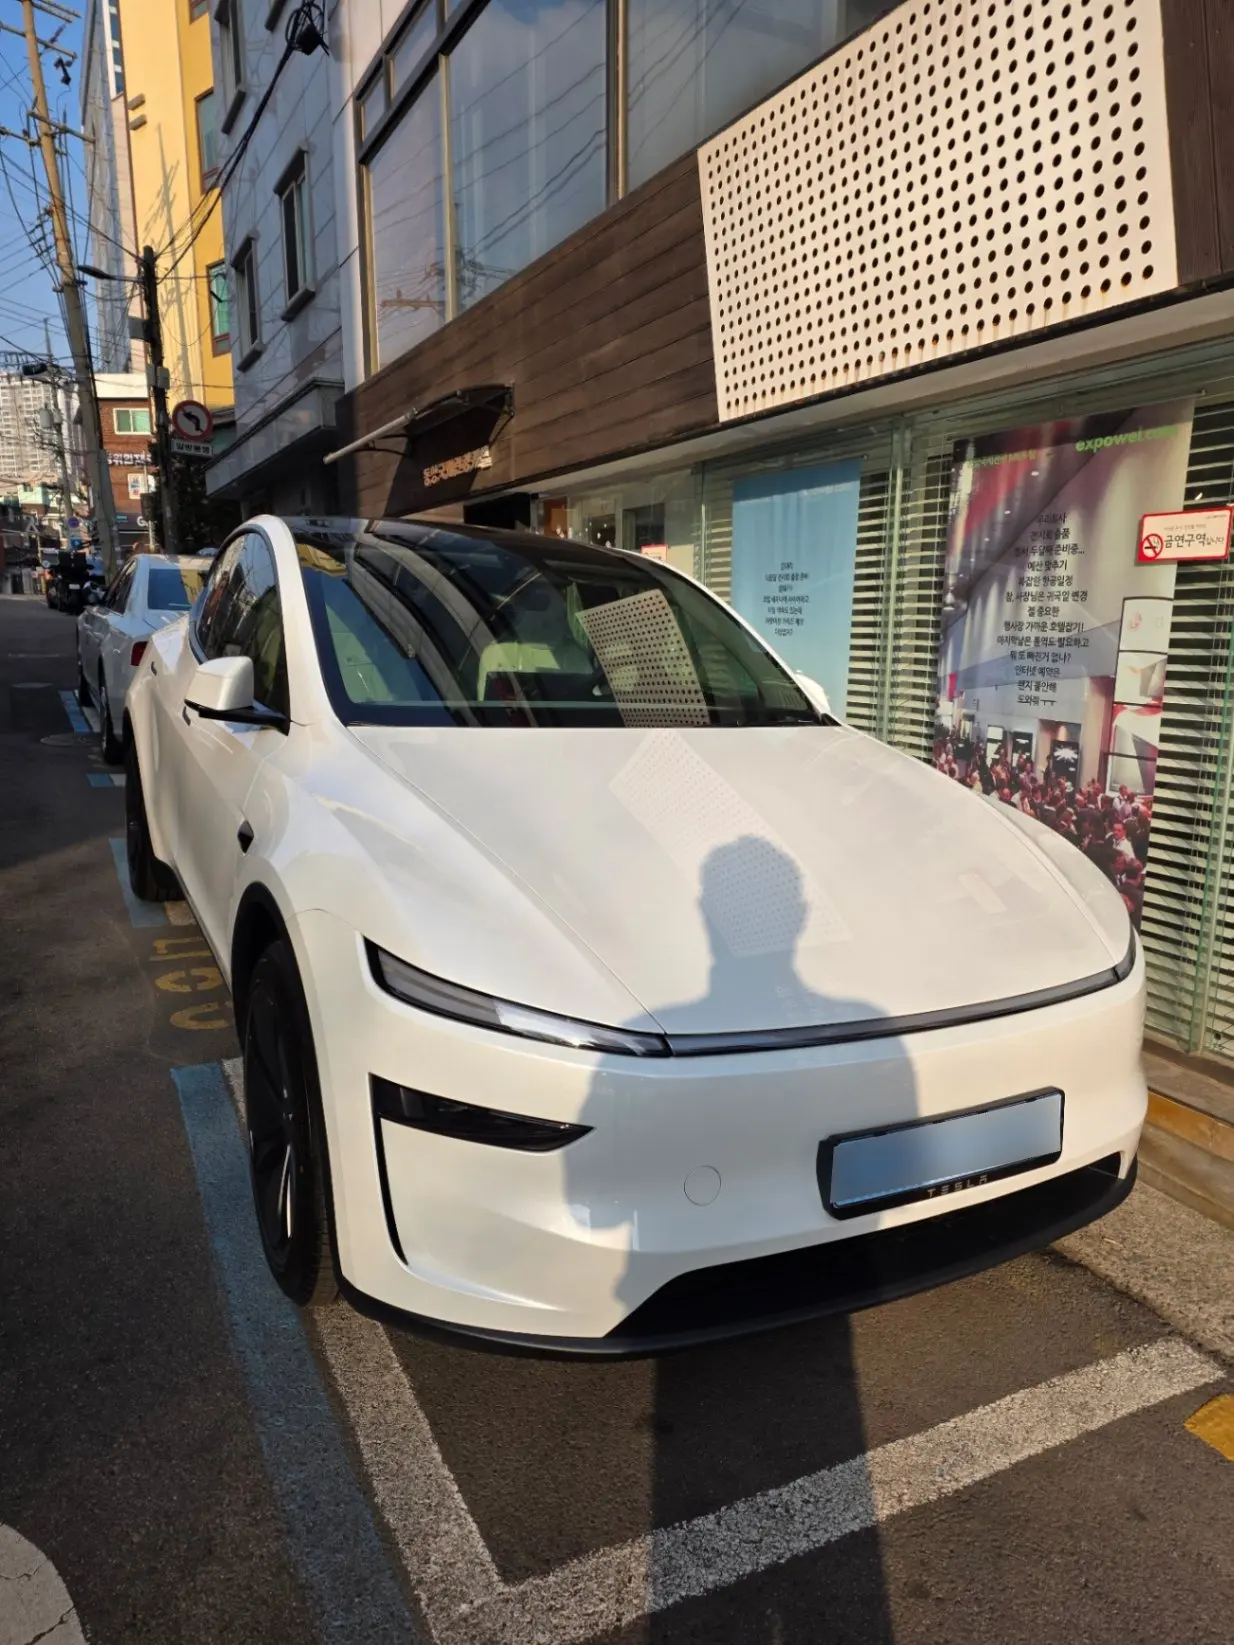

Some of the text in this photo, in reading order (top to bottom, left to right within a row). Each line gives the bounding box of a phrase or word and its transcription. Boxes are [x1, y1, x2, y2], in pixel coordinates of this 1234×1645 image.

[1027, 559, 1068, 572] 예산 맞추기
[1018, 575, 1073, 587] 복잡한 항공일정
[1016, 591, 1045, 602] 사장님은
[1047, 591, 1069, 602] 귀국일
[1071, 590, 1088, 602] 변경
[1037, 606, 1060, 617] 중요한
[1004, 621, 1024, 631] 행사장
[1025, 621, 1048, 632] 가까운
[1034, 636, 1056, 647] 통역도
[1057, 637, 1090, 648] 필요하고
[1051, 652, 1071, 664] 없나?
[1014, 665, 1061, 678] 인터넷 예약은
[1034, 680, 1057, 693] 불안해
[927, 1175, 989, 1199] TESLA
